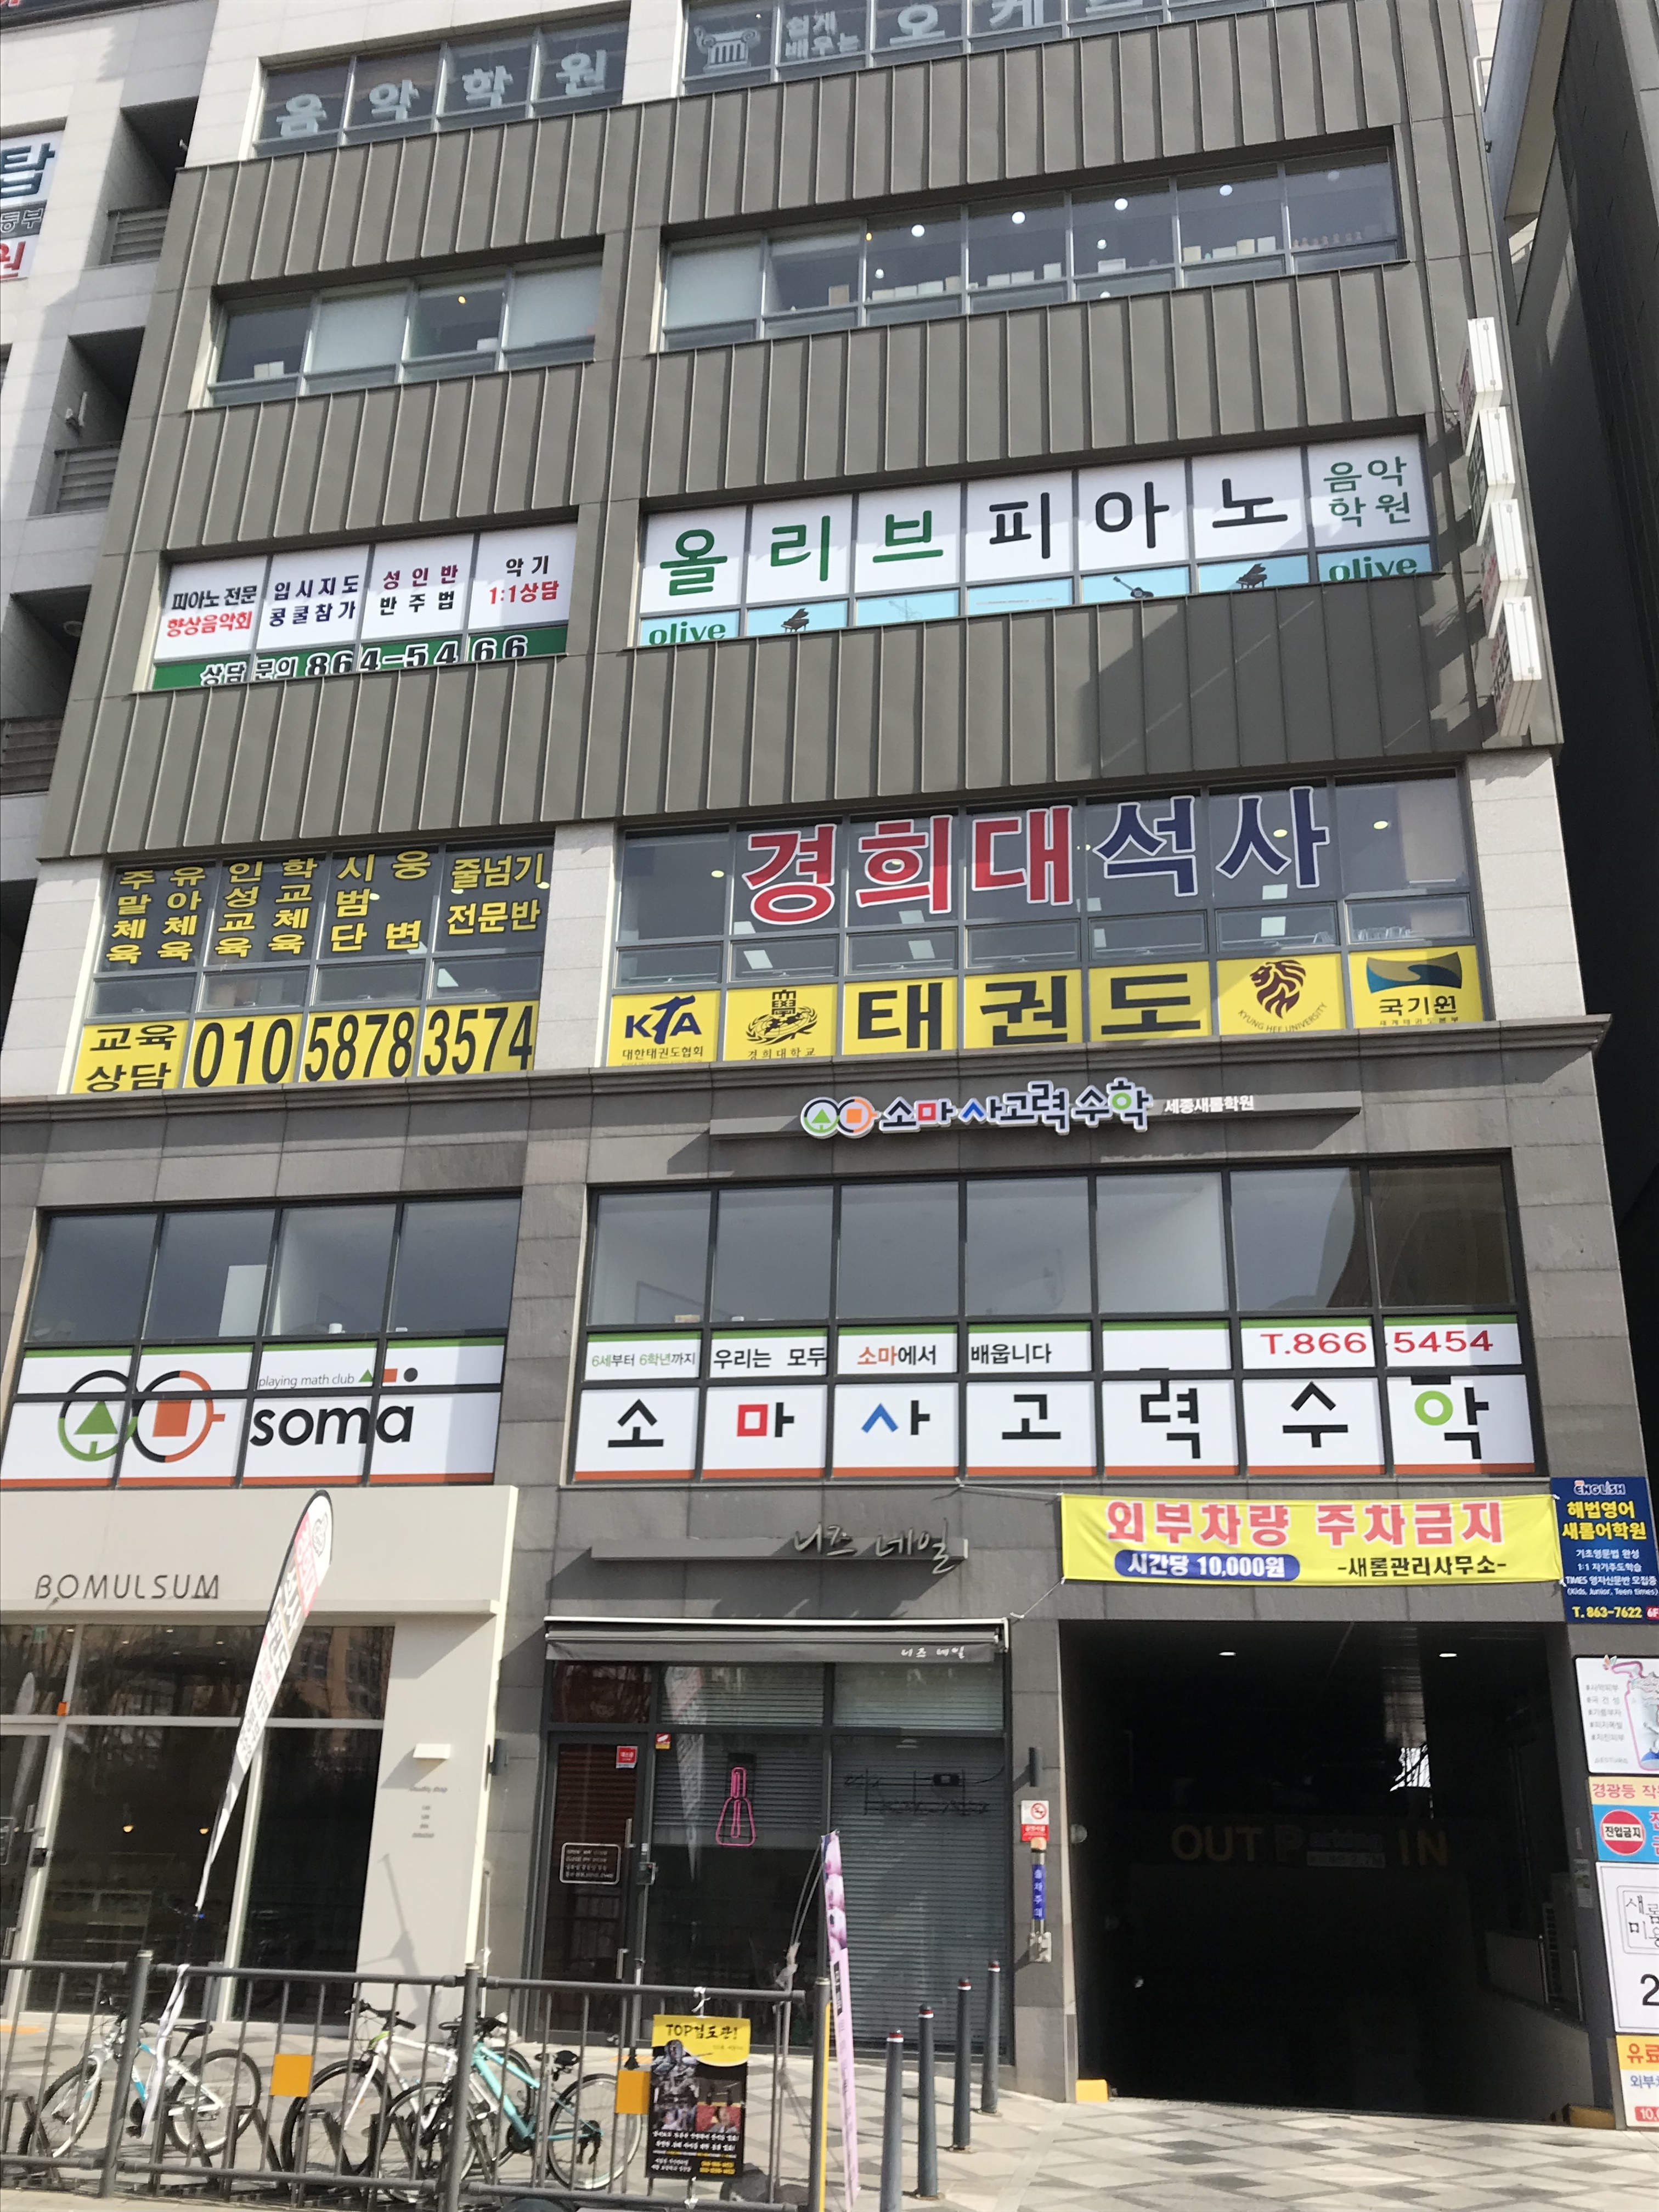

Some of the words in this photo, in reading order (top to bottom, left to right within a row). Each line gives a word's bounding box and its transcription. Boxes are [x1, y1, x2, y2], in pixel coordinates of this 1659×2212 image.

[785, 33, 860, 58] 배우는
[276, 49, 607, 137] 음악학원
[1323, 456, 1407, 493] 음악
[1328, 492, 1412, 528] 학원
[659, 510, 944, 596] 올리브
[989, 478, 1289, 559] 피아노
[383, 565, 458, 590] 성인반
[506, 555, 549, 577] 악기
[1329, 556, 1418, 582] olive
[172, 590, 219, 611] 피아노
[223, 585, 257, 606] 전문
[274, 575, 359, 601] 입시지도
[490, 580, 560, 605] 1:1상담
[167, 611, 252, 637] 향상음악회
[269, 600, 356, 627] 콩쿨참가
[648, 620, 726, 646] olive
[200, 661, 247, 686] 상담
[256, 656, 299, 681] 문의
[305, 635, 528, 677] 864-5466
[742, 805, 1074, 926] 경희대
[1093, 785, 1330, 897] 석사
[452, 853, 544, 889] 줄넘기
[106, 869, 155, 964] 주말체육
[157, 866, 206, 961] 유아체육
[215, 860, 263, 958] 인성교육
[268, 857, 318, 955] 학교체육
[447, 899, 540, 935] 전문반
[857, 973, 1201, 1051] 태권도
[1237, 1008, 1264, 1031] KYUNG
[1284, 1002, 1327, 1032] UNIVERSITY
[1379, 995, 1458, 1016] 국기원
[624, 995, 703, 1045] KTA
[85, 1062, 172, 1093] 상담
[193, 1018, 294, 1088] 010
[304, 1011, 416, 1082] 5878
[424, 1005, 533, 1077] 3574
[89, 1024, 178, 1052] 교육
[623, 1046, 703, 1060] 대한태권도협회
[748, 1047, 816, 1060] 경희대학교
[1070, 1076, 1153, 1133] 수학
[592, 1354, 635, 1368] 6세부터
[639, 1352, 696, 1367] 6학년까지
[713, 1348, 771, 1369] 우리는
[787, 1347, 827, 1367] 모두
[856, 1344, 938, 1367] 소마에서
[971, 1343, 1052, 1365] 배웁니다
[258, 1374, 300, 1390] playing
[301, 1374, 330, 1386] math
[331, 1373, 355, 1385] club
[249, 1404, 415, 1447] soma
[1106, 1500, 1291, 1547] 외부차량
[1316, 1501, 1505, 1547] 주차금지
[1567, 1501, 1635, 1519] 해법영어
[1127, 1554, 1190, 1577] 시간당
[1195, 1554, 1286, 1579] 10,000원
[35, 1574, 220, 1599] BOMULSUM
[1593, 1783, 1636, 1799] 경광등
[1642, 1784, 1659, 1799] 작
[1605, 1826, 1641, 1838] 진입금지
[1630, 2075, 1659, 2089] 외부
